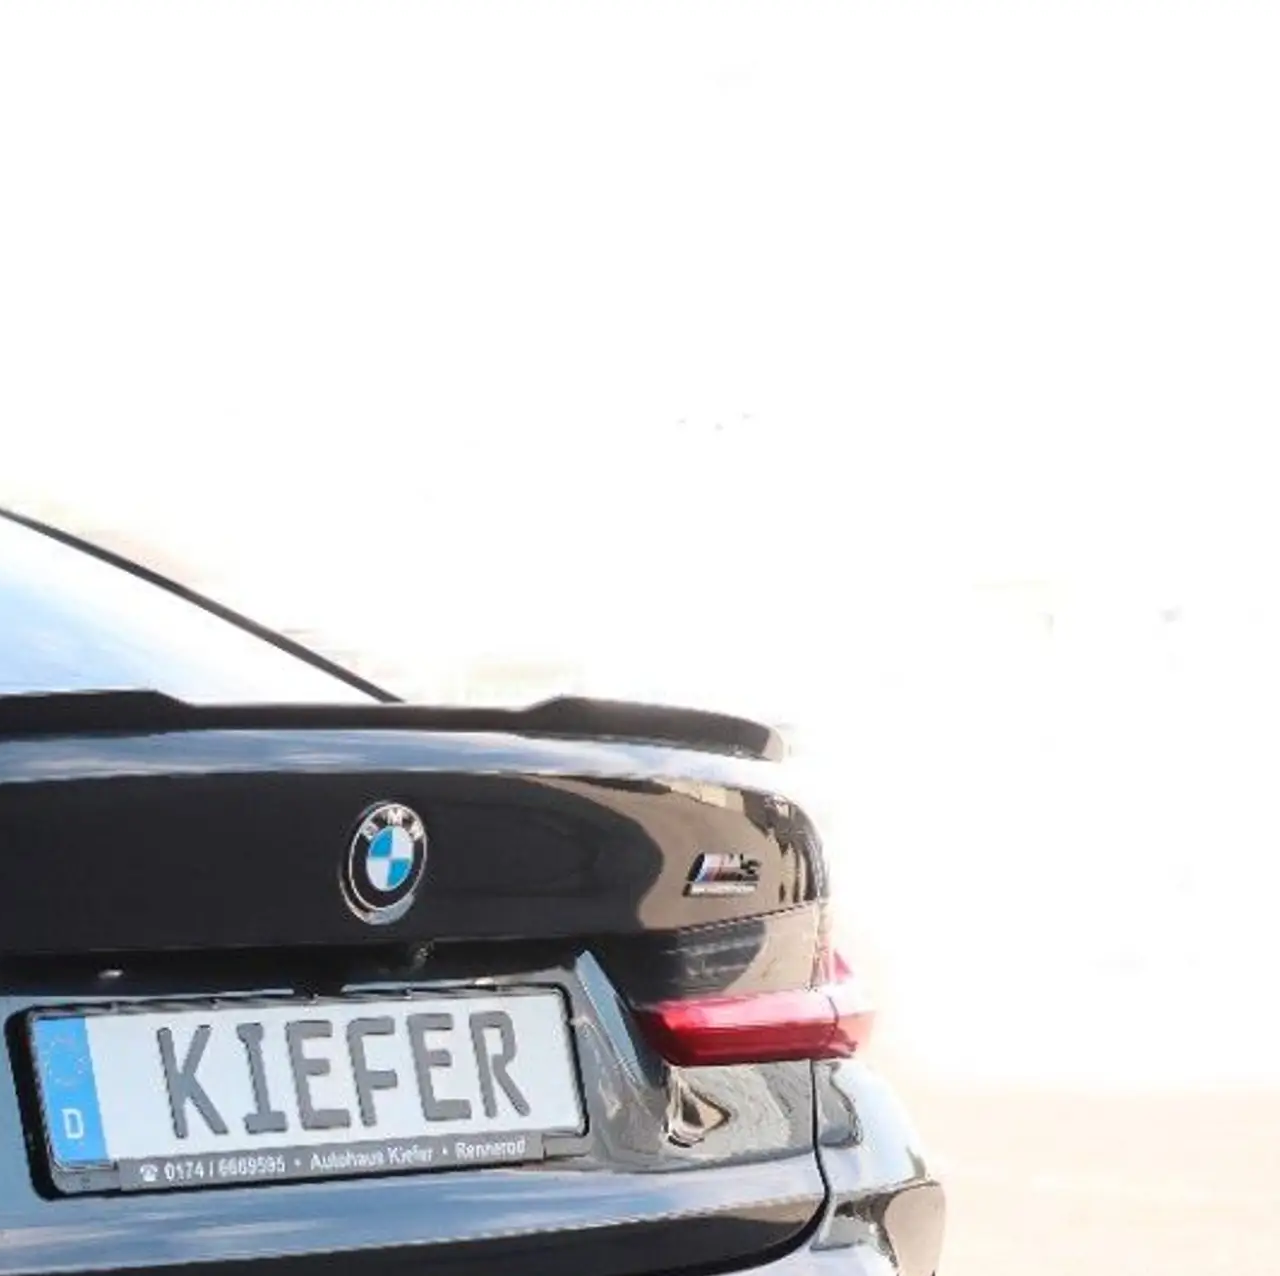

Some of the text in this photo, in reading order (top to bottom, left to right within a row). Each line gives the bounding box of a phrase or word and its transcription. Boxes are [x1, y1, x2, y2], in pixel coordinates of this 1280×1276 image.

[359, 807, 425, 841] BMW
[156, 1011, 531, 1138] KIEFER
[63, 1108, 85, 1139] D
[163, 1161, 205, 1181] 0174
[310, 1151, 384, 1171] Autohaus
[387, 1145, 433, 1165] Kiefer
[455, 1137, 526, 1160] Rennerod
